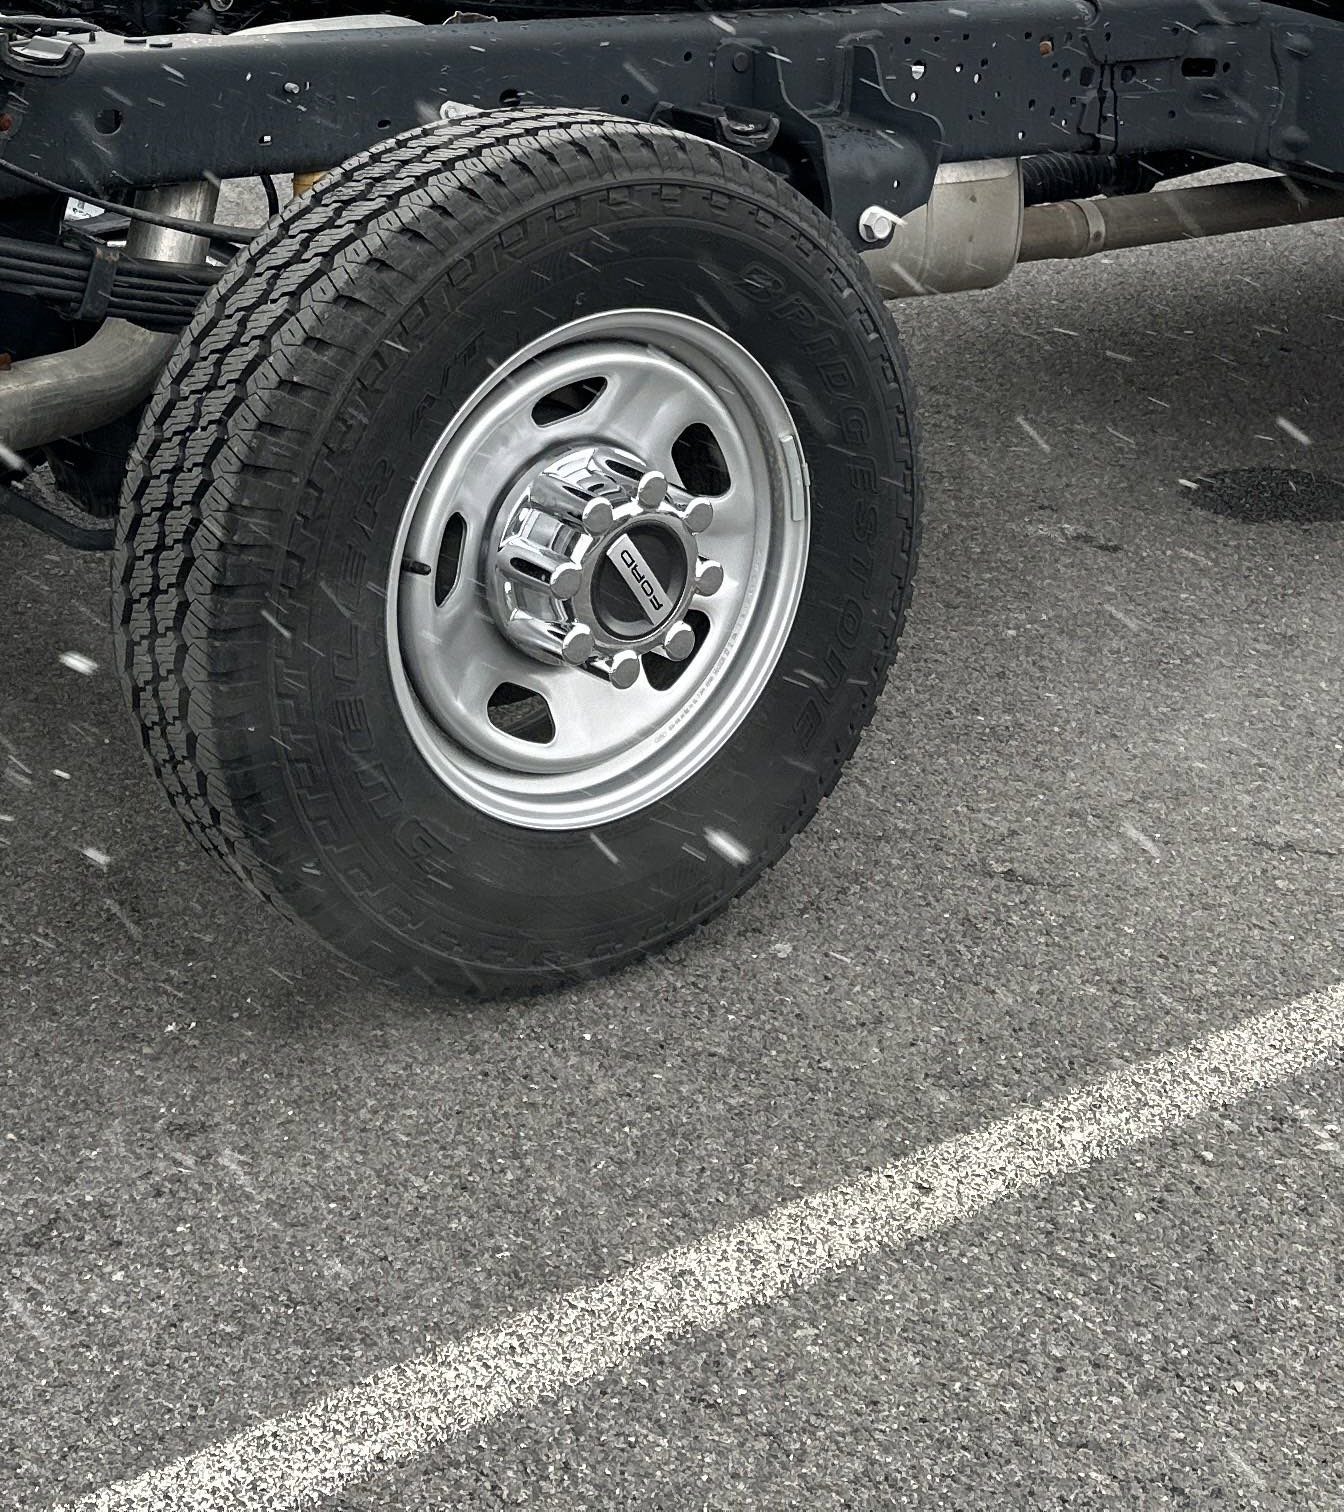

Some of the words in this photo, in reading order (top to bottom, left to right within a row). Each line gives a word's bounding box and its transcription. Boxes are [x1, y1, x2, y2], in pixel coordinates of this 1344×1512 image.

[336, 458, 456, 878] DUELER
[621, 550, 663, 610] FORD
[738, 262, 877, 750] BRIDGESTONE
